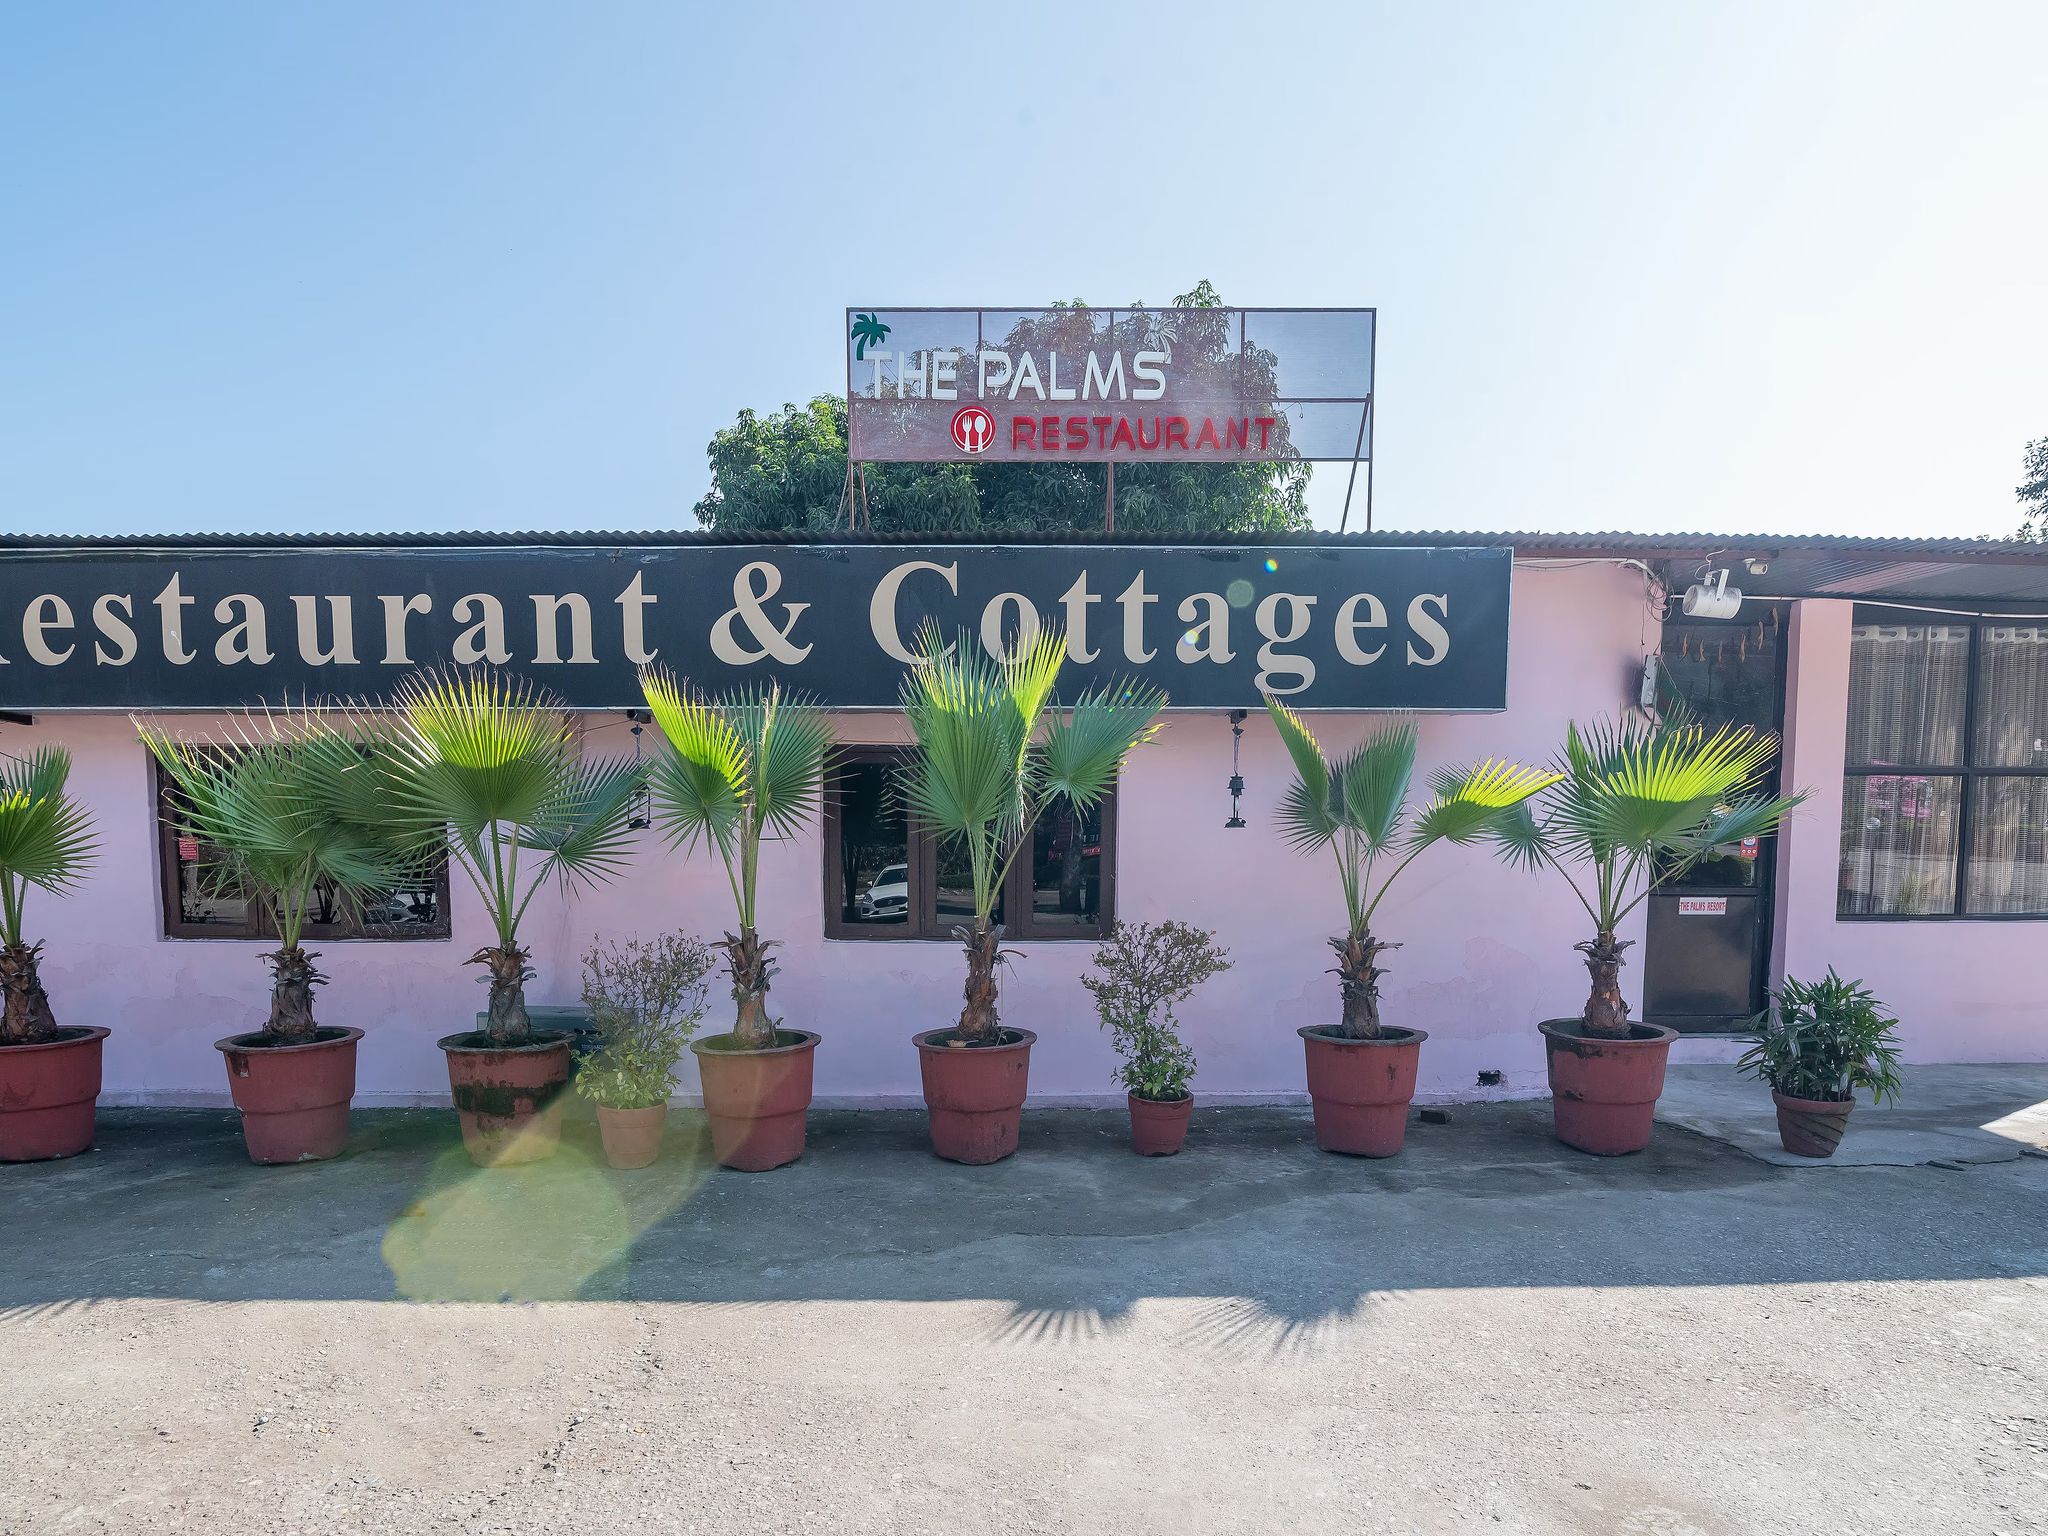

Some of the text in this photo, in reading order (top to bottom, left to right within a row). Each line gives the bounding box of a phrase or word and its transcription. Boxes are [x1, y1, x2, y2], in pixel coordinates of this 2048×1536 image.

[864, 352, 1170, 400] THE PALMS
[1012, 416, 1274, 451] RESTAURANT
[0, 560, 1450, 694] estaurant & Cottages
[1680, 901, 1726, 911] THE PALMS RESORT
